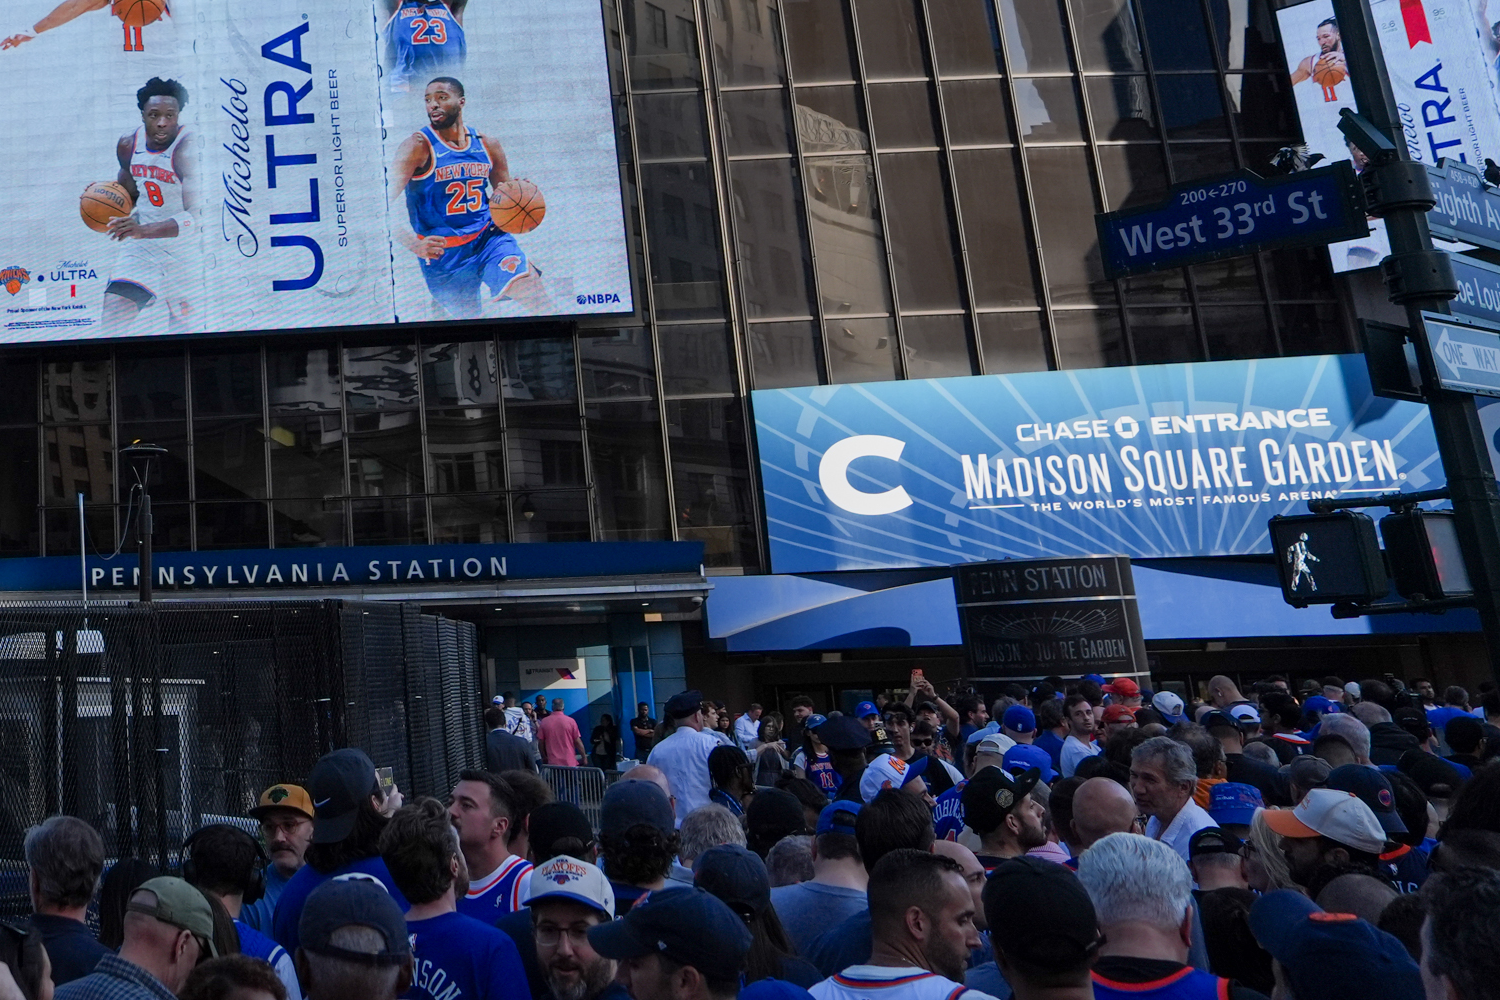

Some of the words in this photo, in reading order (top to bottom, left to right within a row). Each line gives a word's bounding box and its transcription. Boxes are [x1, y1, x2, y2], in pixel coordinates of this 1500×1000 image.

[1381, 20, 1396, 29] 2.6
[1432, 8, 1446, 17] 95
[410, 18, 447, 45] 23
[328, 68, 340, 111] BEER
[1414, 62, 1468, 165] TRA
[331, 113, 343, 162] LIGHT
[220, 76, 259, 258] Michelob
[261, 21, 324, 291] ULTRA
[435, 164, 464, 182] NEW
[464, 162, 491, 179] YORK
[143, 181, 164, 207] 8
[334, 165, 348, 247] SUPERIOR
[445, 178, 484, 216] 25
[1180, 188, 1207, 206] 200
[1219, 180, 1247, 197] 270
[1118, 214, 1207, 257] West
[1213, 195, 1276, 240] 33rd
[1287, 189, 1328, 226] St
[50, 269, 98, 281] ULTRA
[587, 293, 620, 304] NBPA
[1454, 279, 1476, 306] oe
[1442, 341, 1468, 366] ONE
[1472, 346, 1499, 371] WAY
[1016, 420, 1110, 442] CHASE
[1151, 408, 1331, 436] ENTRANCE
[817, 433, 914, 516] C
[961, 452, 1113, 500] MADISON
[1119, 444, 1252, 495] SQUARE
[1258, 438, 1400, 488] GARDEN
[1030, 503, 1062, 513] THE
[1065, 498, 1143, 510] WORLD'S
[1149, 496, 1195, 508] MOST
[1202, 494, 1271, 505] FAMOUS
[1278, 491, 1334, 502] ARENA
[368, 554, 509, 582] STATION
[1024, 564, 1107, 592] STATION
[1079, 637, 1126, 660] GARDEN
[819, 773, 835, 789] 11
[541, 862, 587, 875] PLAYOFFS
[410, 957, 462, 1000] NSON
